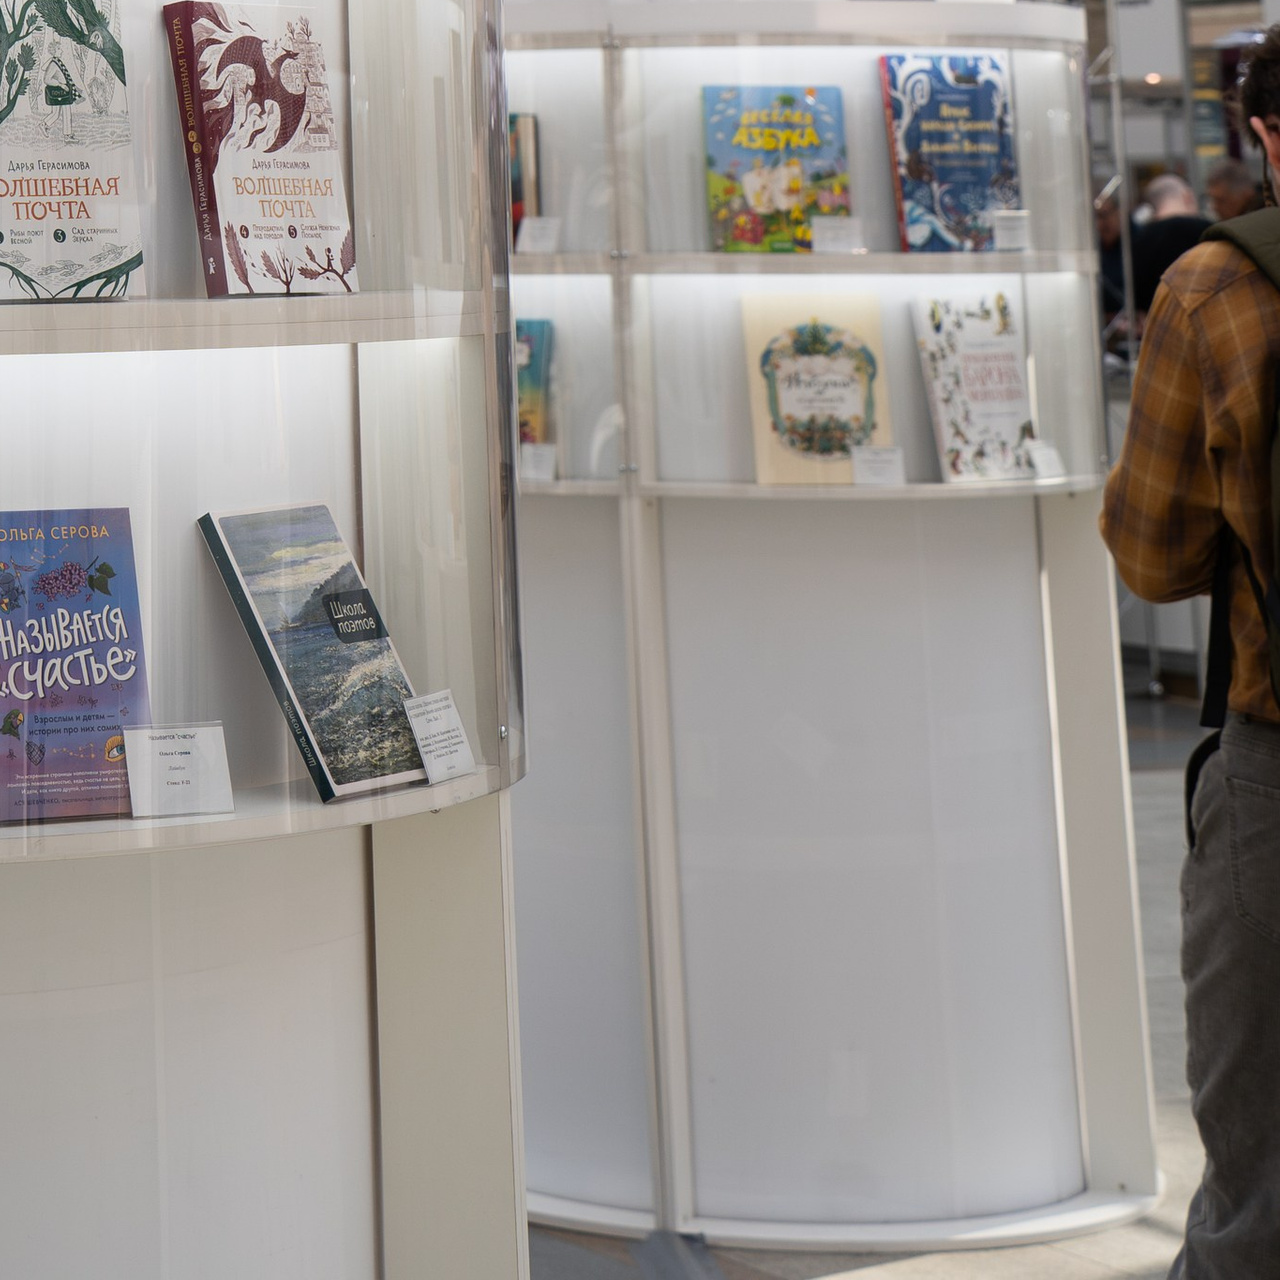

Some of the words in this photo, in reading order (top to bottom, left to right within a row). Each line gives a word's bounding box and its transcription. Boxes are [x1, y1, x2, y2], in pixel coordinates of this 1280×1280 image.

[732, 126, 819, 151] АЗБУКА
[232, 176, 334, 196] ВОЛШЕБНАЯ
[13, 200, 91, 220] ПОЧТА
[258, 199, 316, 218] ПОЧТА
[50, 525, 110, 539] СЕРОВА
[329, 601, 366, 619] Школа
[337, 617, 376, 634] поэтов
[34, 715, 74, 724] Взрослым
[83, 714, 105, 723] детям
[29, 728, 61, 736] истории
